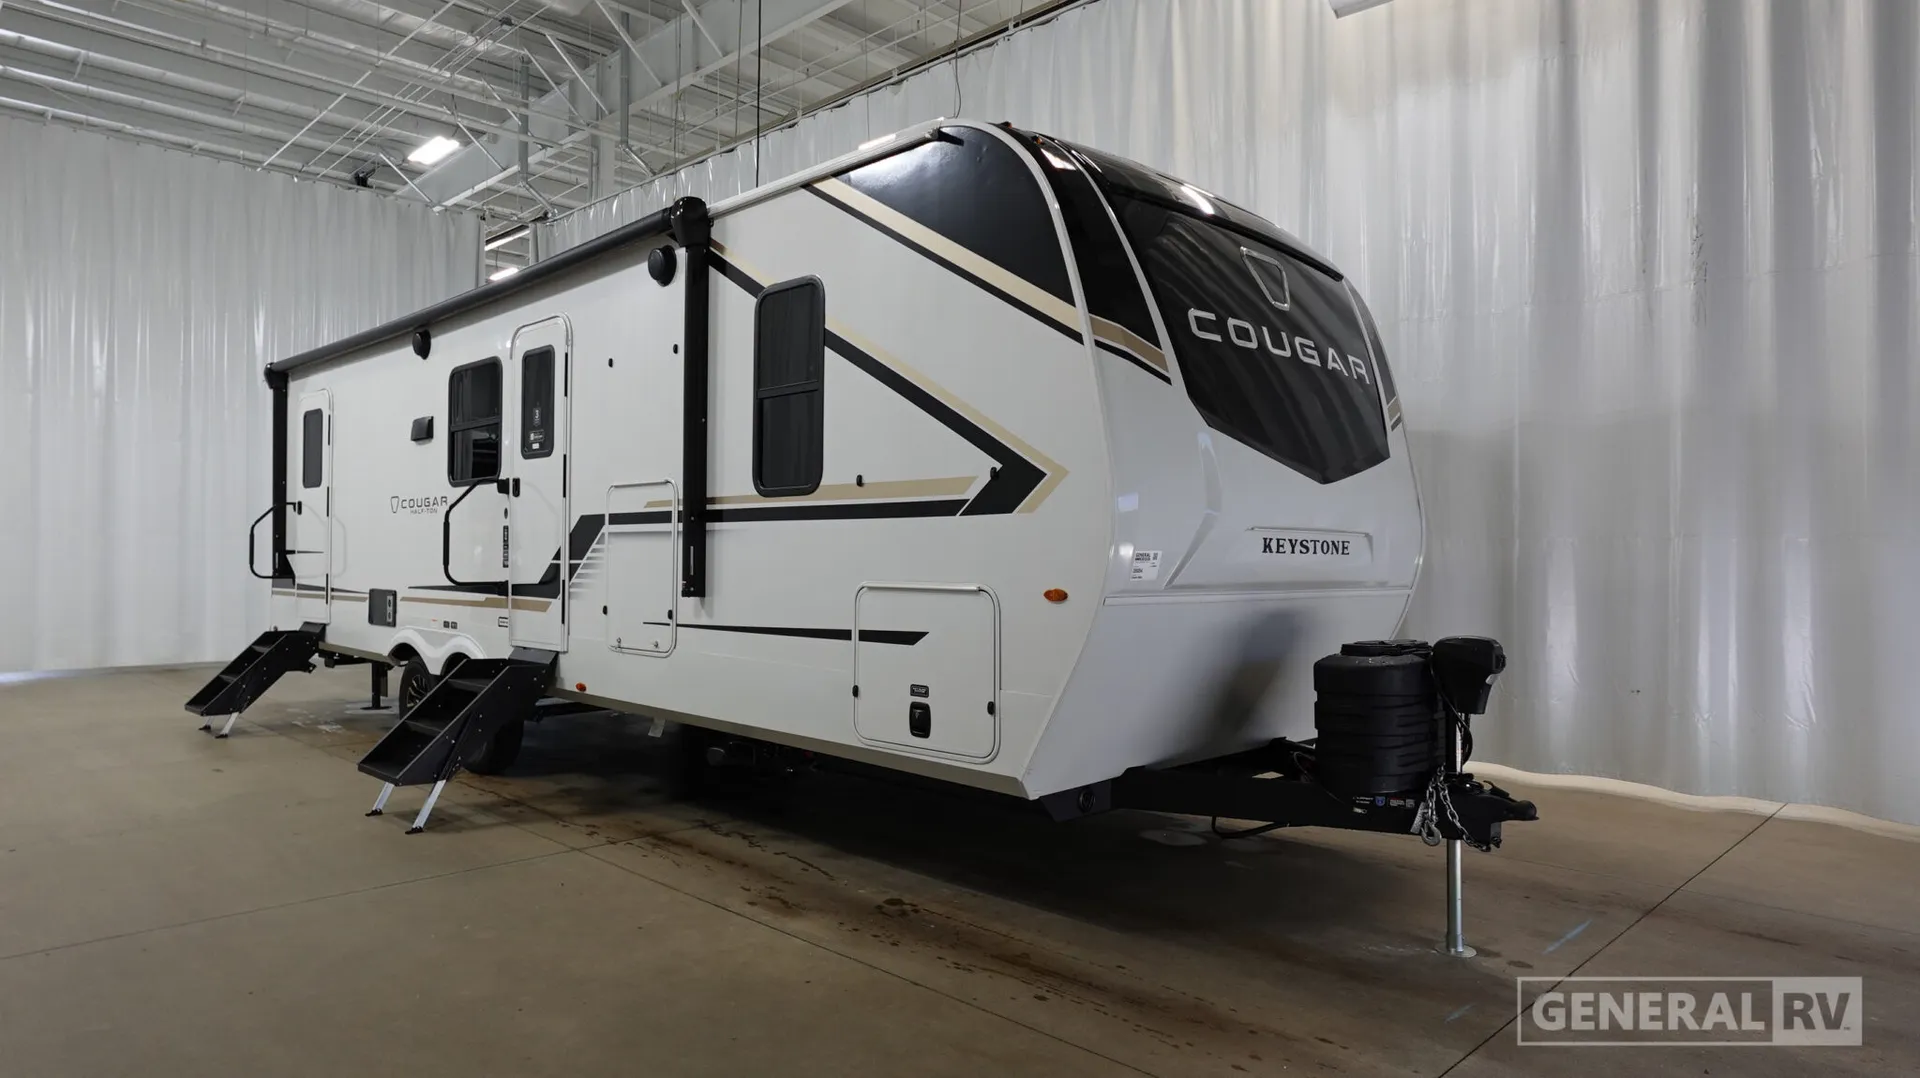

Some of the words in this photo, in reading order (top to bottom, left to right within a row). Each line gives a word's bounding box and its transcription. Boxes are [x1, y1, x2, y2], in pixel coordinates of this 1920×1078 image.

[1187, 307, 1371, 385] COUGAR
[400, 496, 448, 509] COUGAR
[1261, 536, 1351, 556] KEYSTONE
